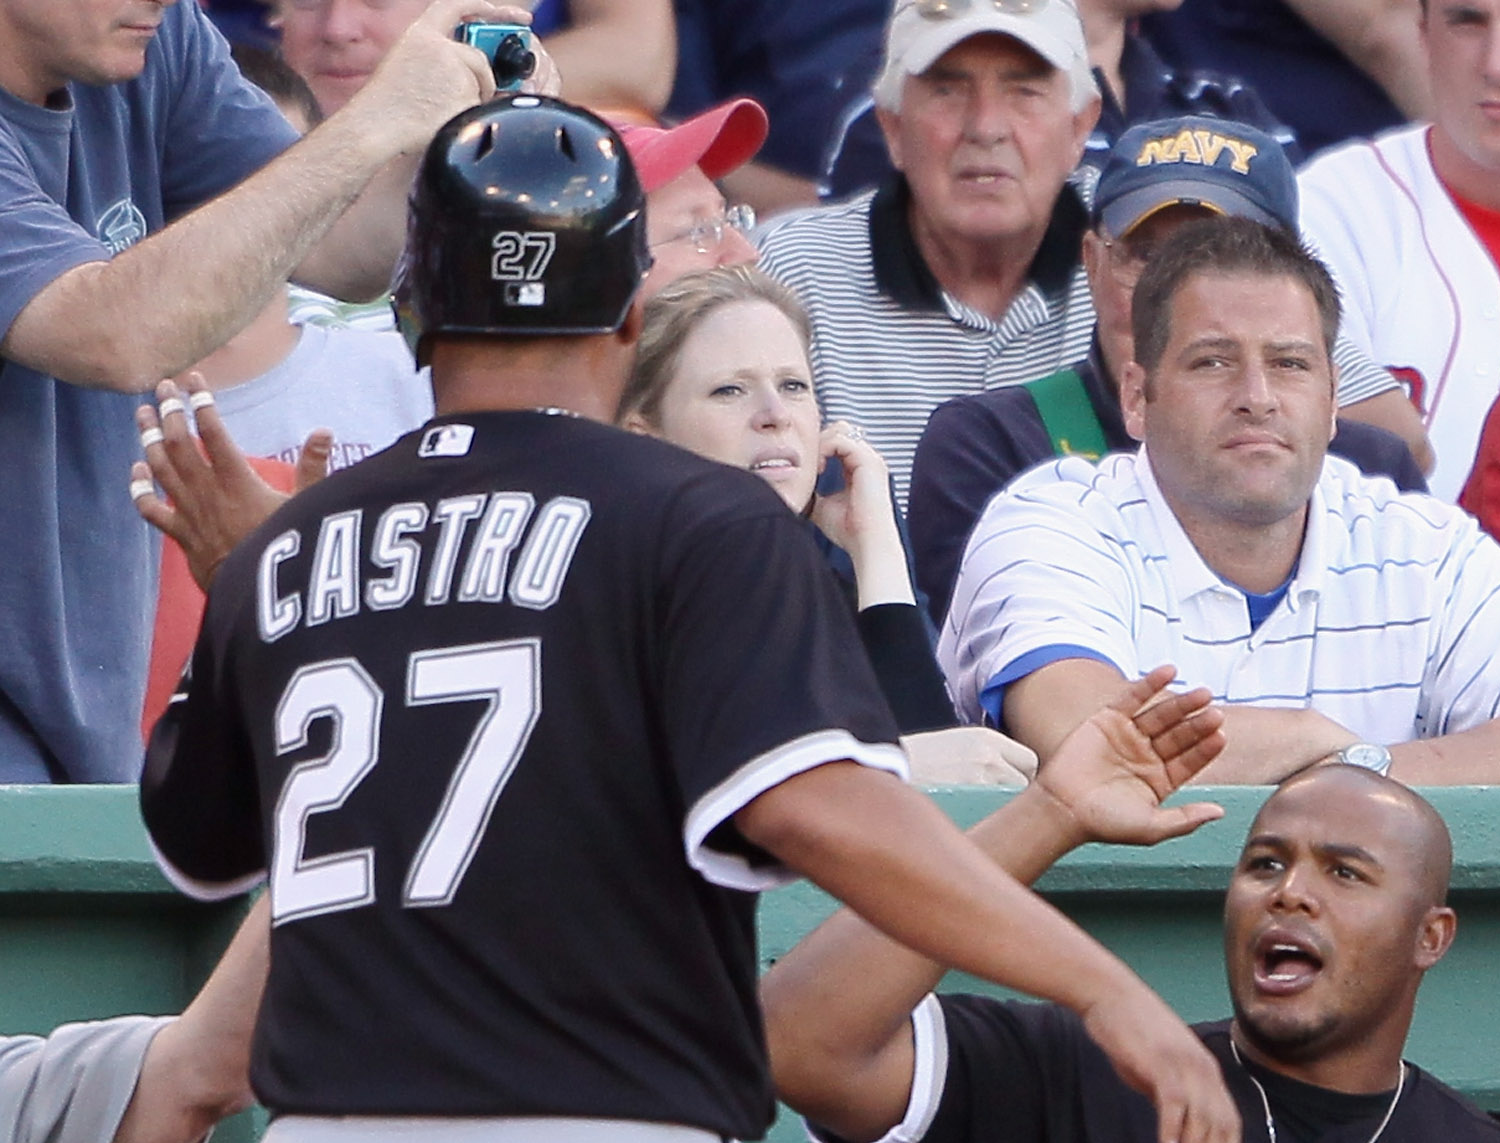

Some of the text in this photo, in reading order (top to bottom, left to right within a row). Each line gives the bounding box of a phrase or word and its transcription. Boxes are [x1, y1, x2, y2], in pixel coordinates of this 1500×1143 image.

[1136, 129, 1258, 175] NAVY
[491, 231, 556, 281] 27
[256, 490, 592, 643] CASTRO
[270, 636, 542, 928] 27
